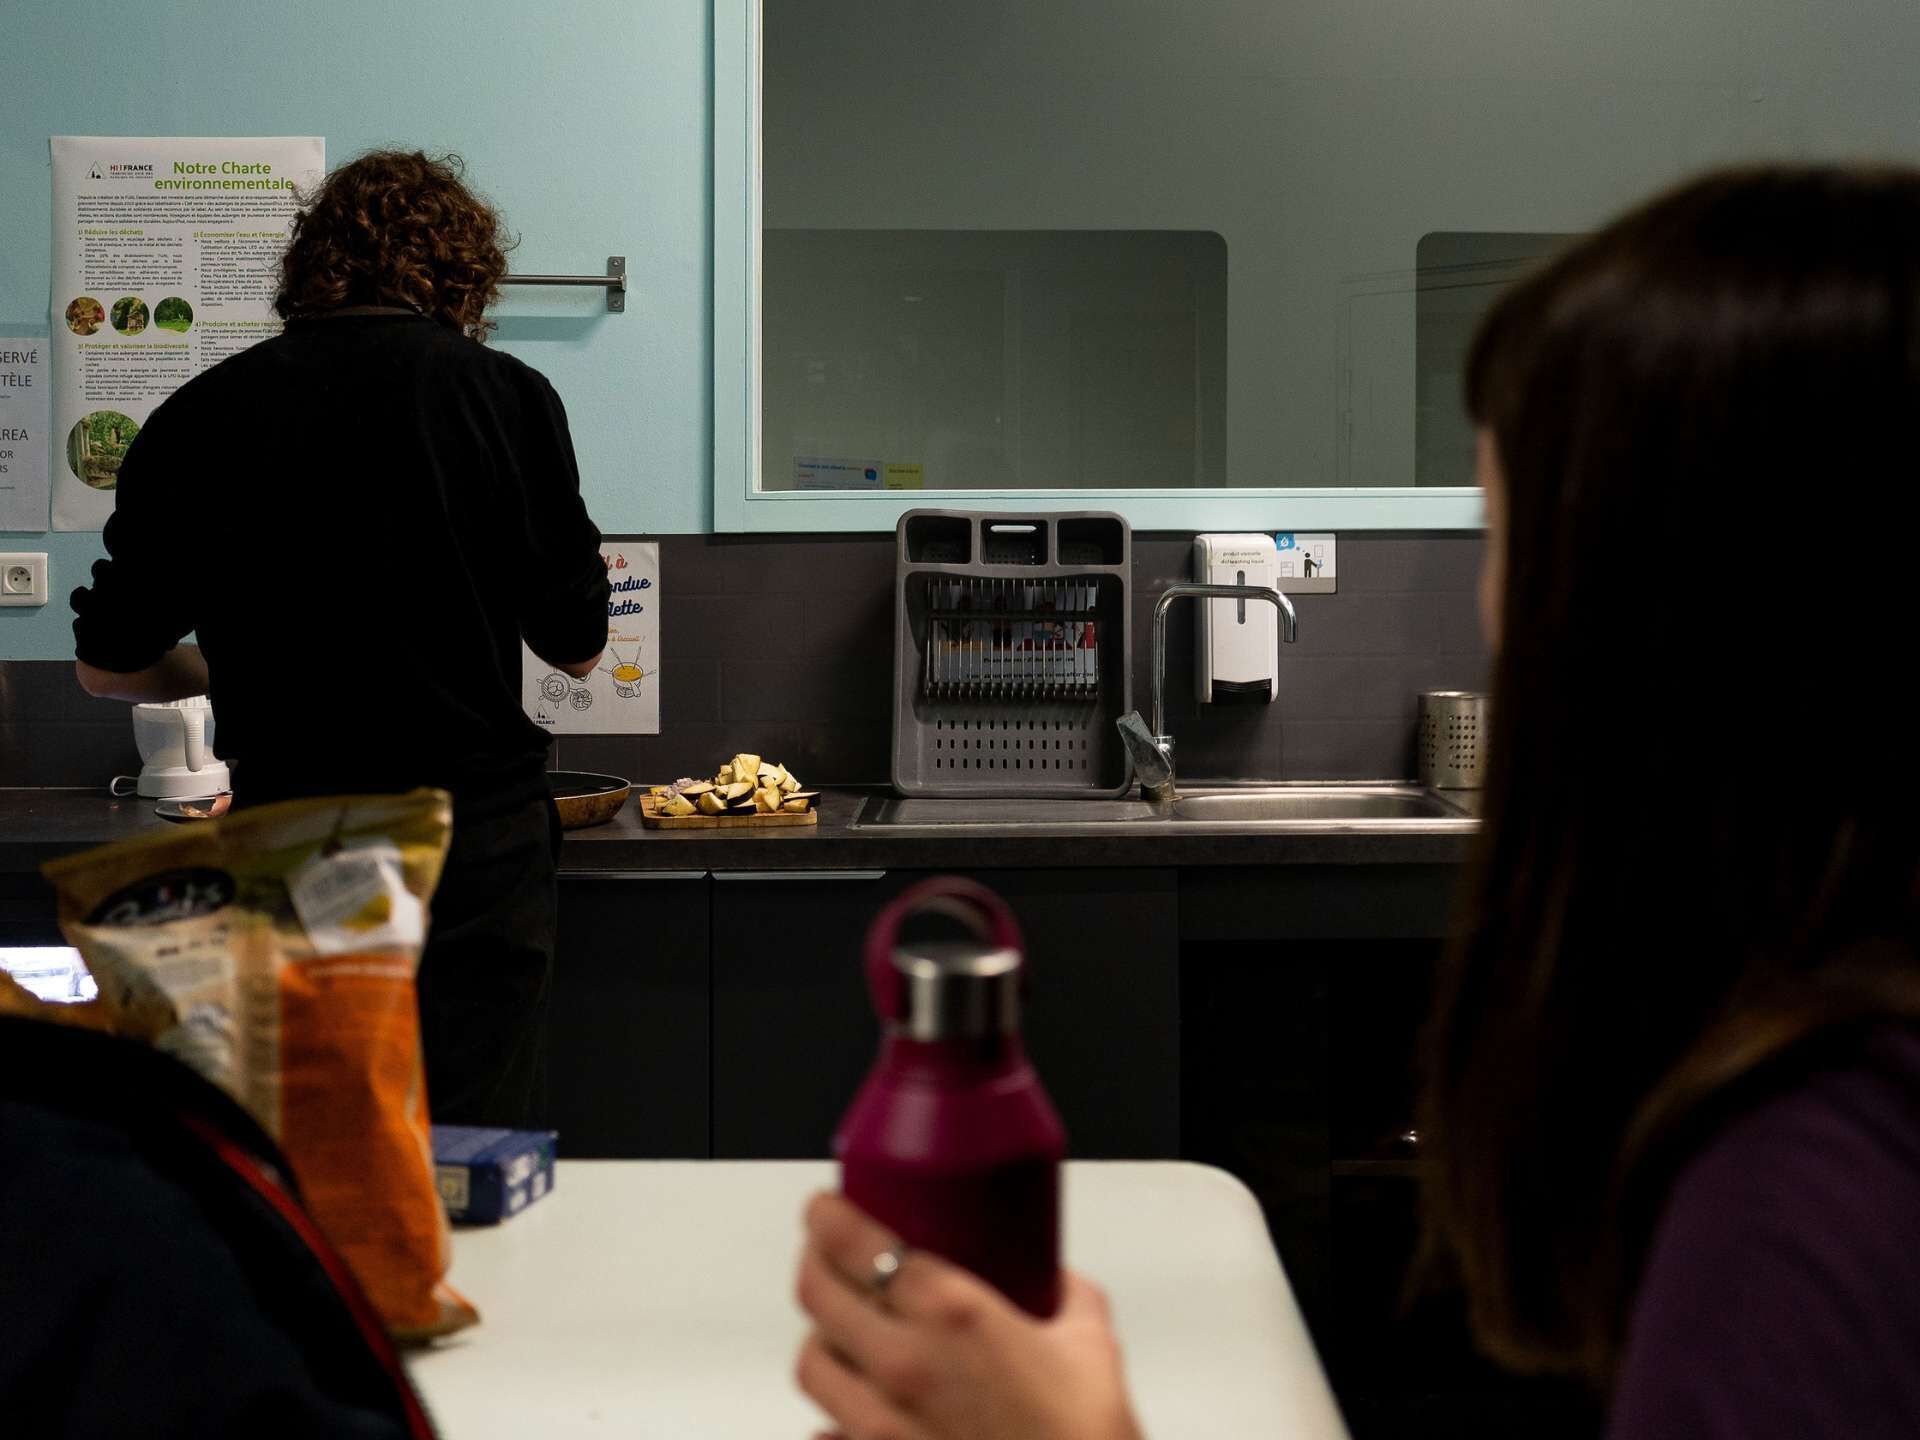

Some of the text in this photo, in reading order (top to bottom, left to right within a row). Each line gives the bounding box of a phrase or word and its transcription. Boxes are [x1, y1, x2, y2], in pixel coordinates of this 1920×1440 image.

[174, 162, 272, 174] Notre Charte
[155, 177, 294, 190] environnementale
[1, 371, 32, 386] TÈLE
[0, 428, 28, 441] REA
[616, 553, 628, 568] à
[608, 576, 652, 592] ndue
[608, 599, 644, 617] lette
